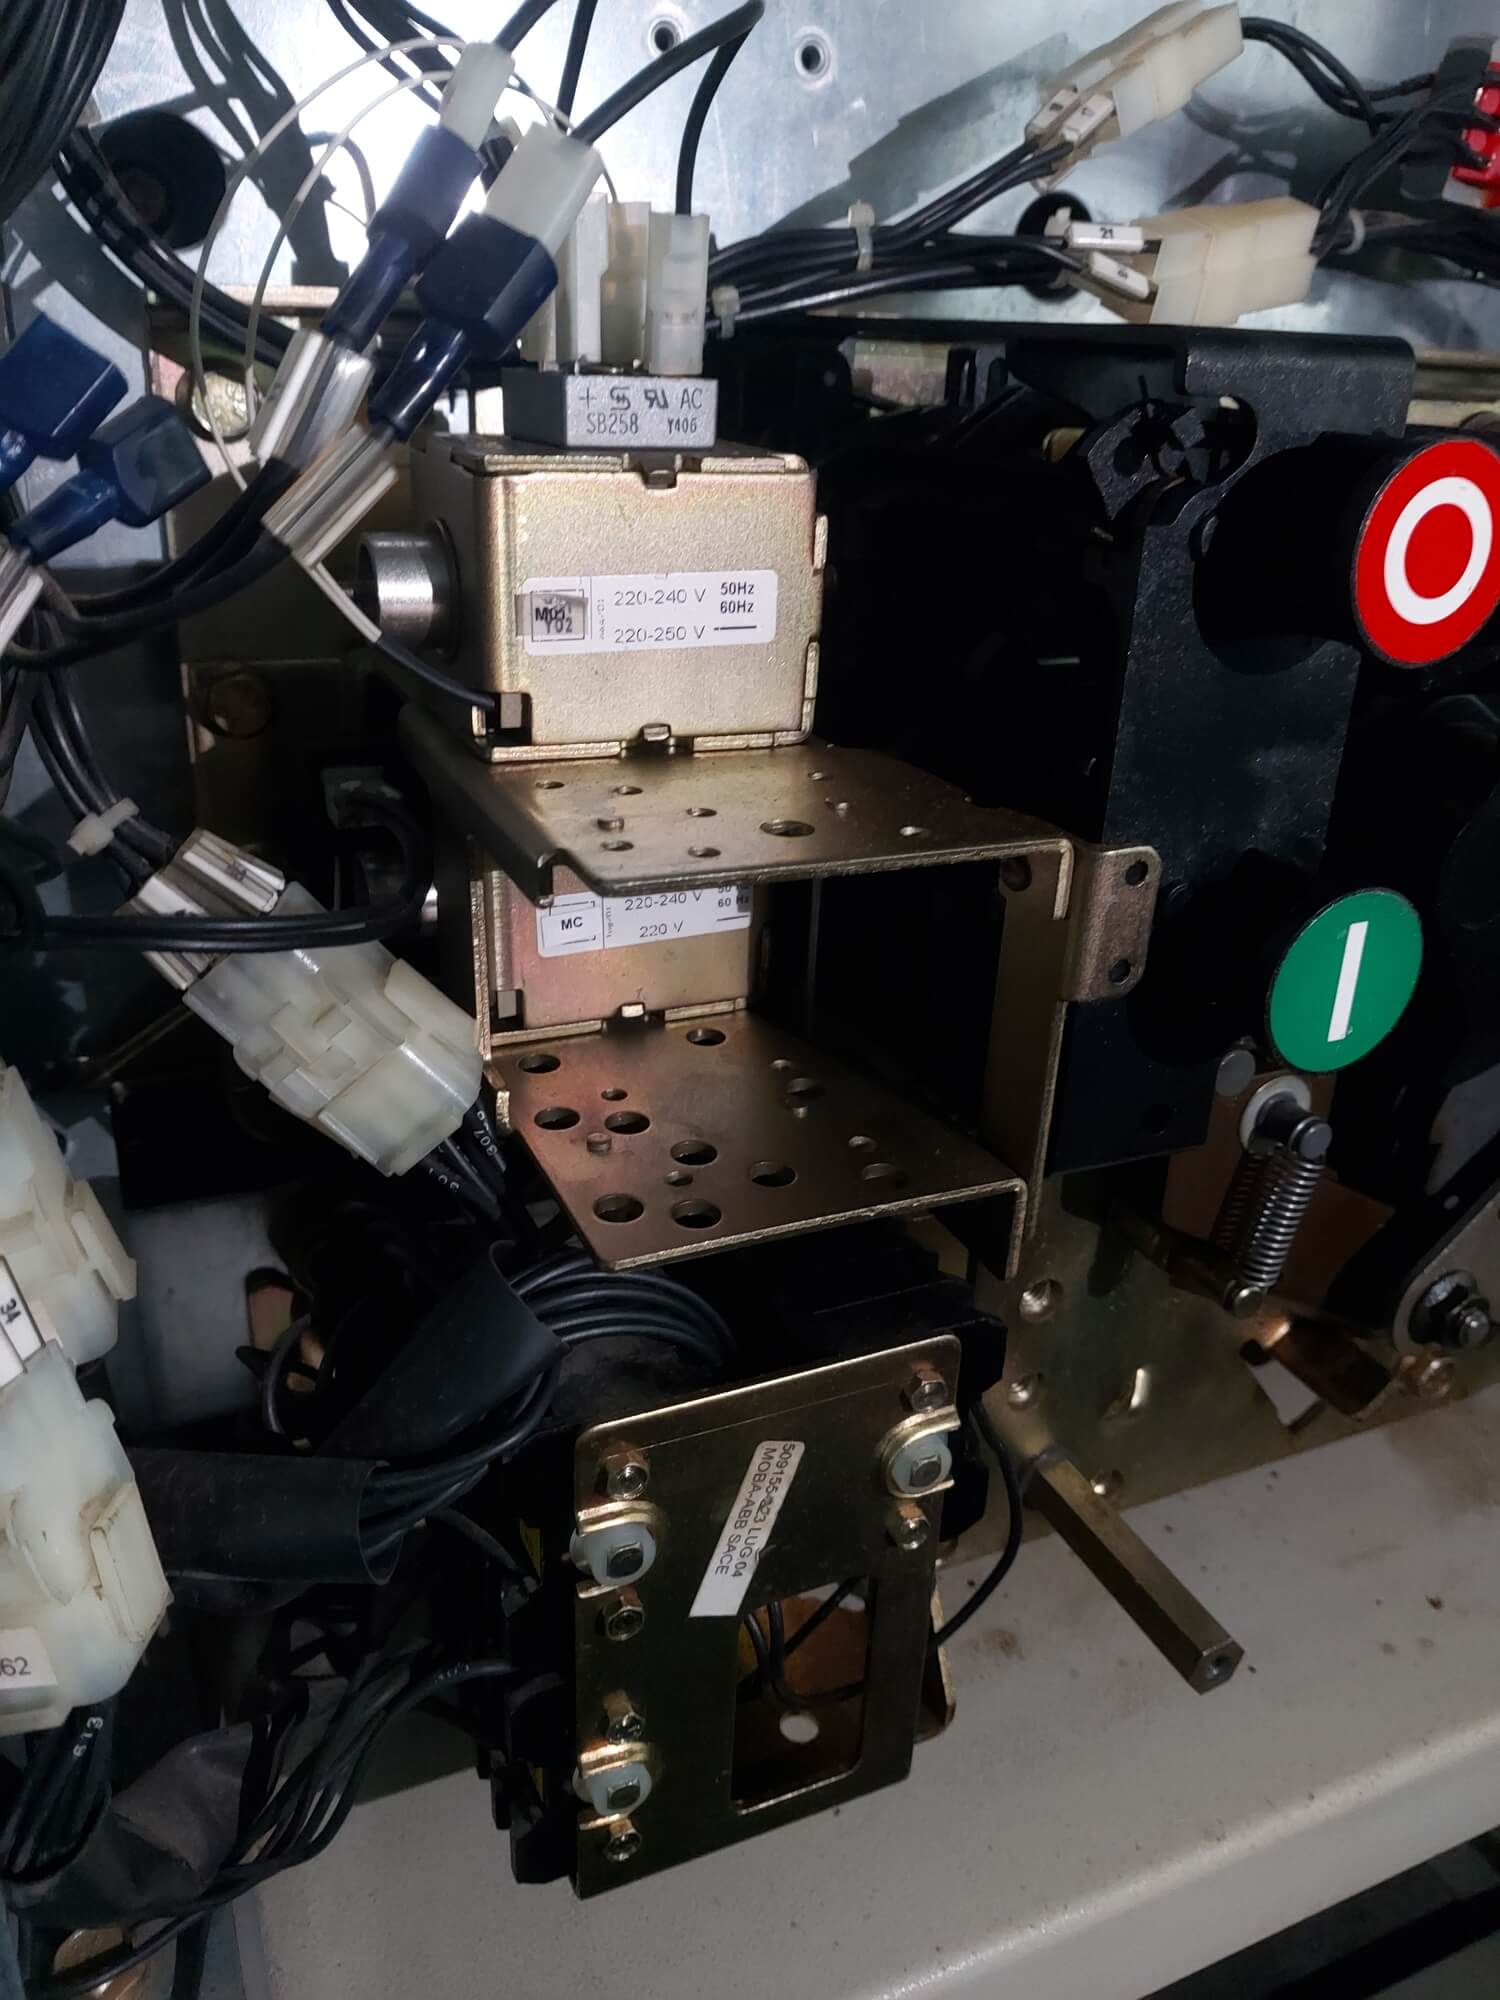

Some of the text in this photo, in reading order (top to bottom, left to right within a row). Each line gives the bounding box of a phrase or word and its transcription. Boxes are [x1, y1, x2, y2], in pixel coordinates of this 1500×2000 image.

[680, 387, 703, 409] AC
[586, 412, 697, 435] SB258 Y406
[613, 588, 706, 607] 220-240 V
[720, 582, 755, 596] 50Hz
[720, 600, 755, 614] 60Hz
[613, 625, 706, 644] 220-250 V
[624, 889, 704, 912] 220-240 V
[718, 897, 732, 908] 60
[561, 916, 583, 931] MC
[639, 921, 684, 938] 220 V
[714, 1447, 778, 1576] MOBA-ABB SACE
[0, 1656, 32, 1677] 62
